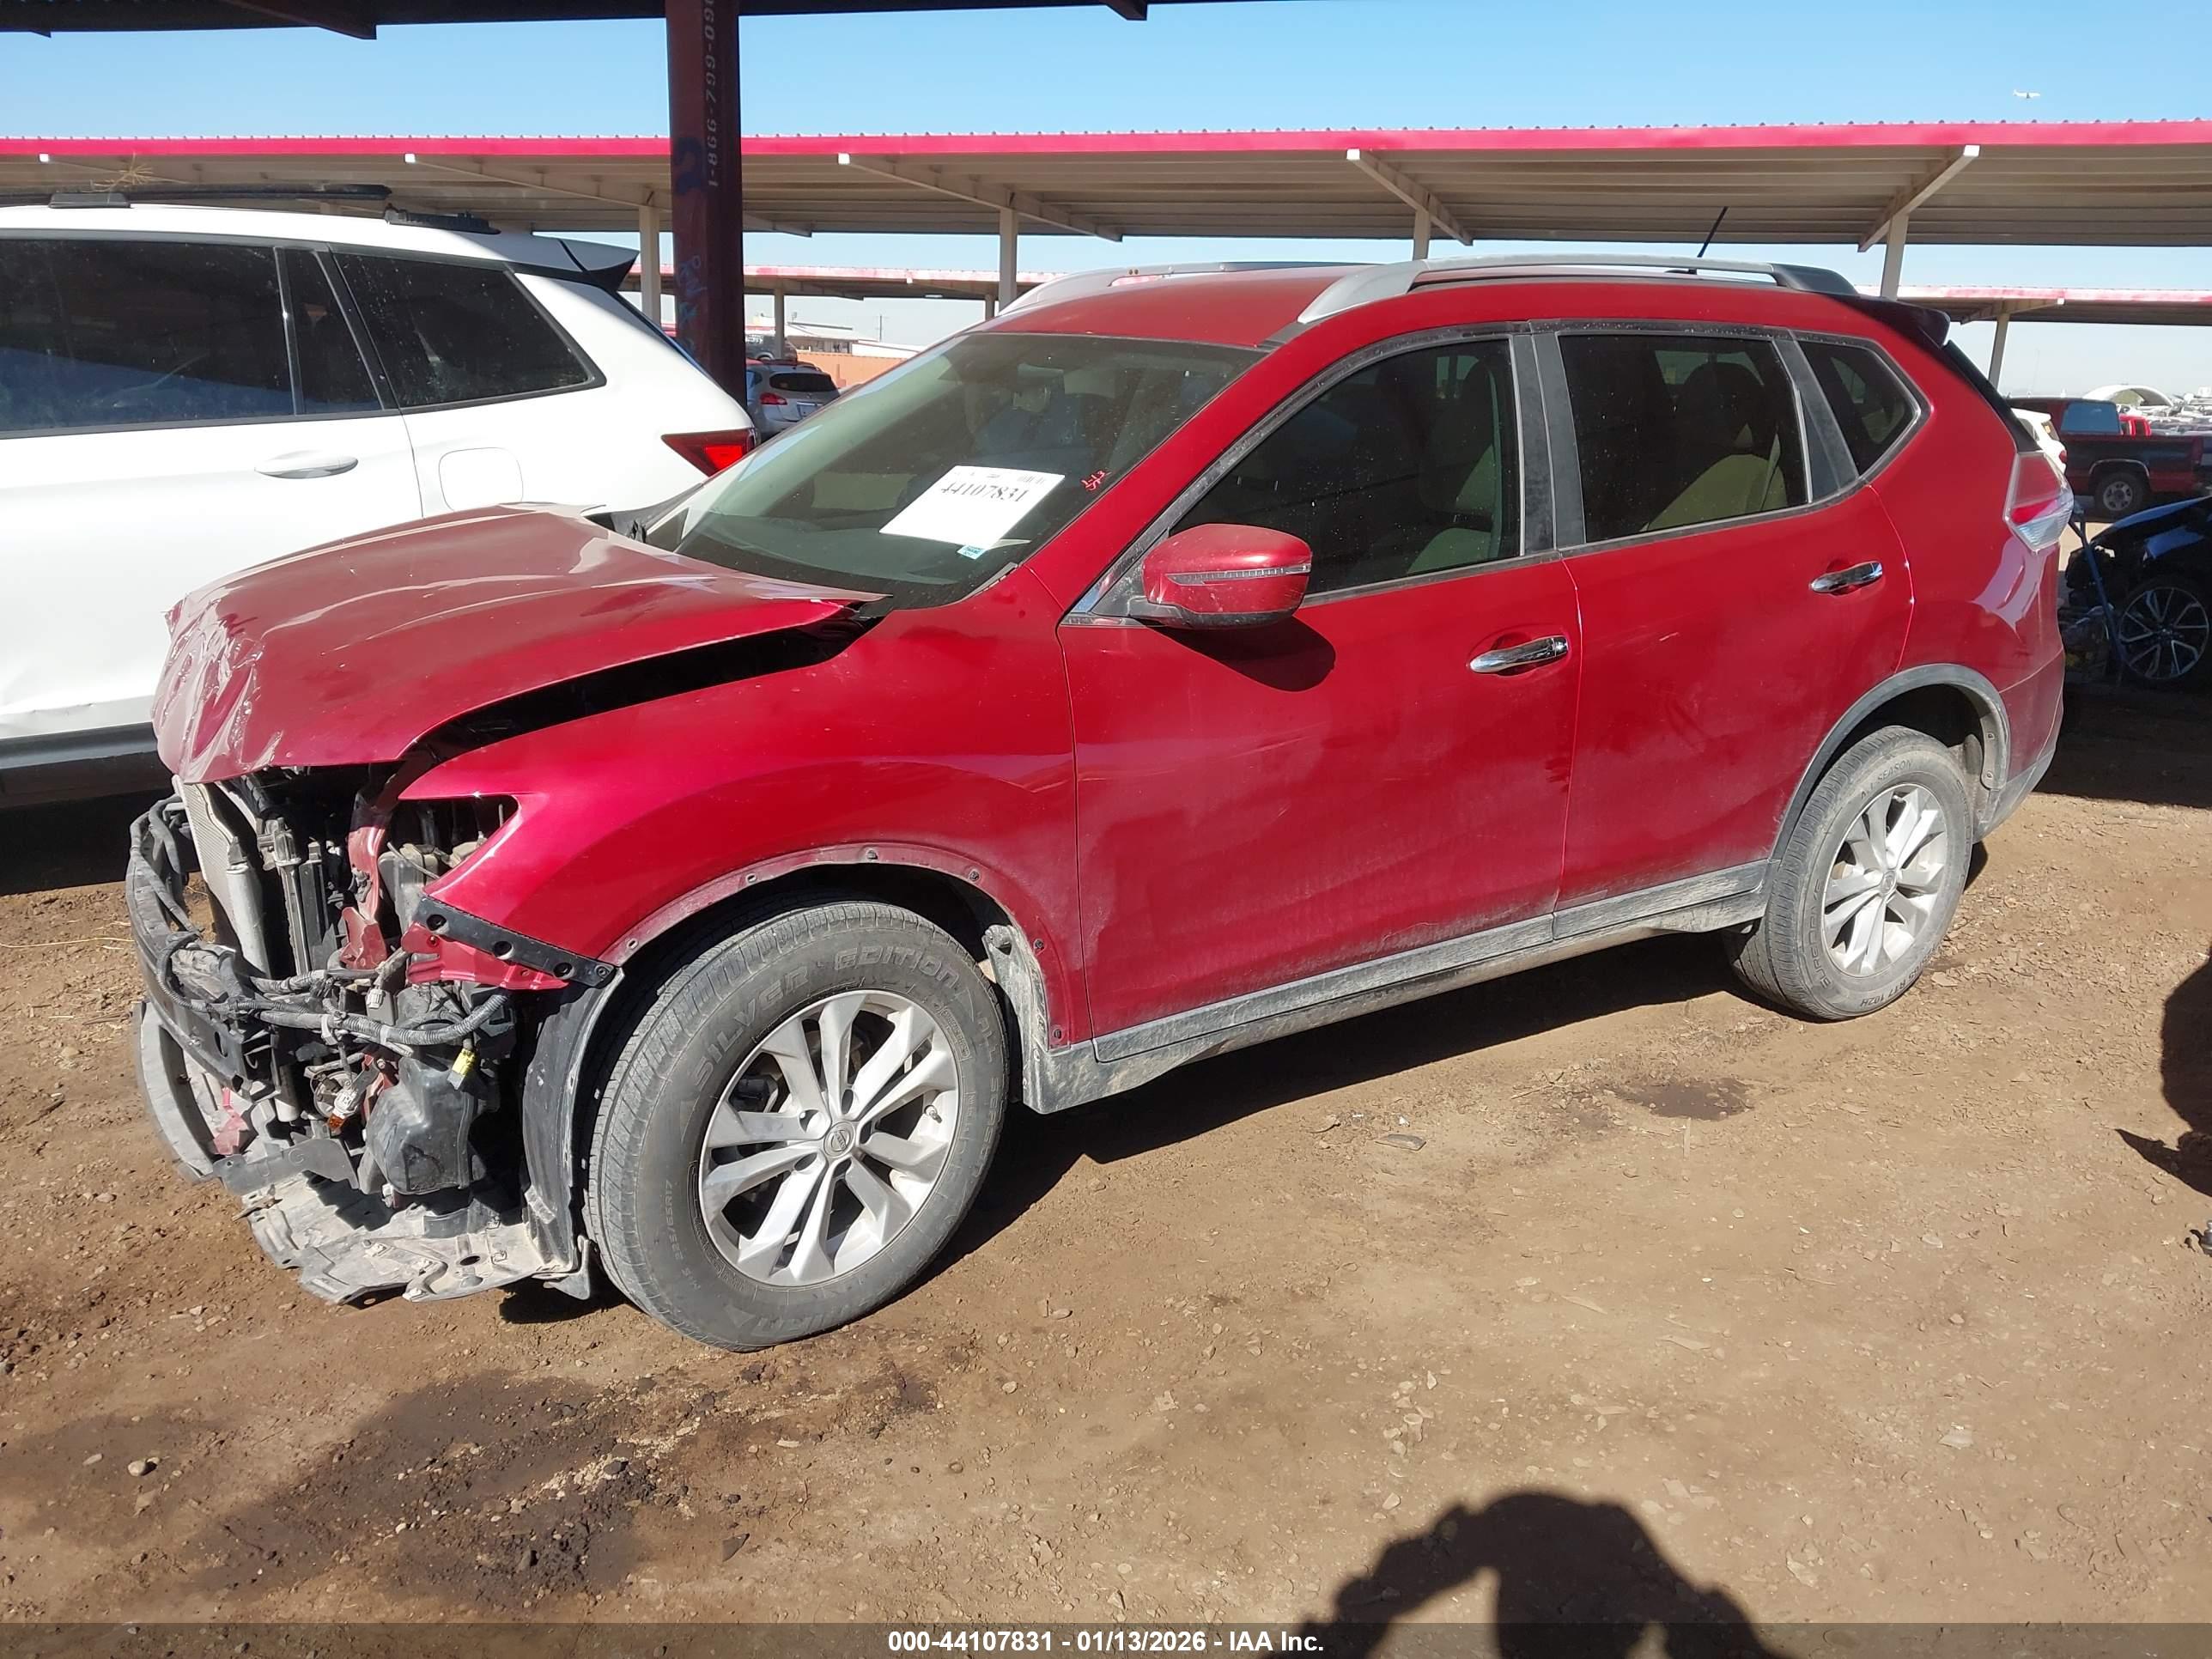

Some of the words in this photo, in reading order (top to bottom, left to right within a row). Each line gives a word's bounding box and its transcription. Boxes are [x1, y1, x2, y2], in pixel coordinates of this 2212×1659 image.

[940, 480, 1030, 501] 44107831
[1859, 994, 1885, 1007] 102H
[690, 966, 809, 1091] SILVER
[834, 945, 960, 989] EDITION
